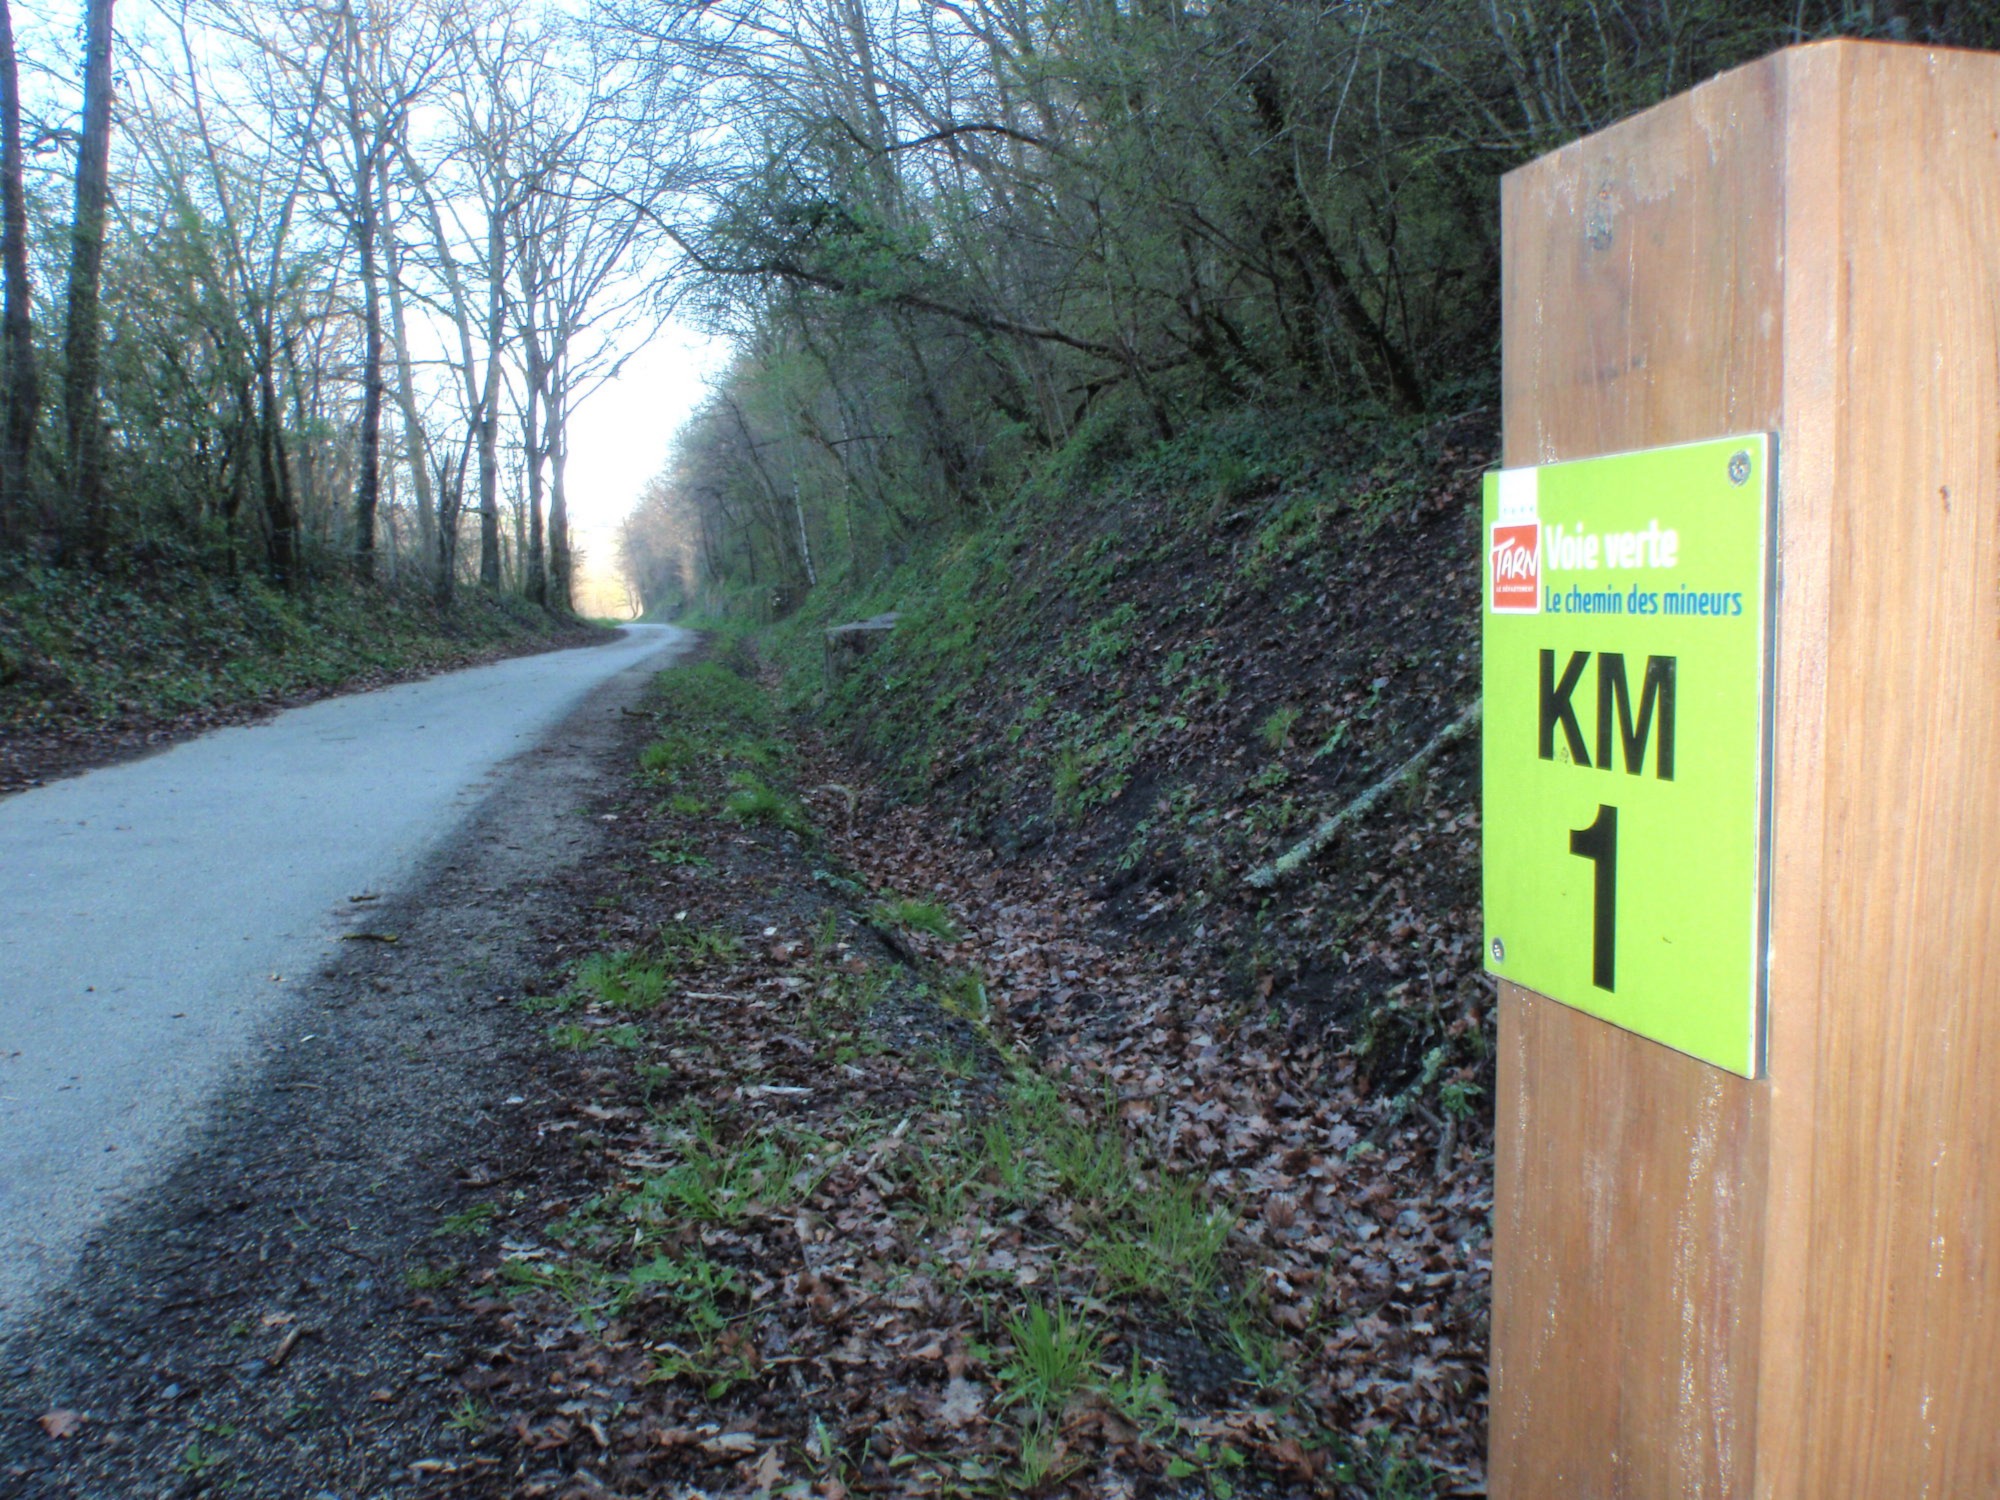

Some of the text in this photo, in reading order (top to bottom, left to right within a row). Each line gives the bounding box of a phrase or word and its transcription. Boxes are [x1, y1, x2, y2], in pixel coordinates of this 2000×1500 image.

[1489, 537, 1539, 582] TARN
[1545, 518, 1677, 570] Voie verte
[1545, 583, 1742, 617] Le chemin des mineurs
[1538, 648, 1677, 781] KM
[1569, 804, 1618, 993] 1
